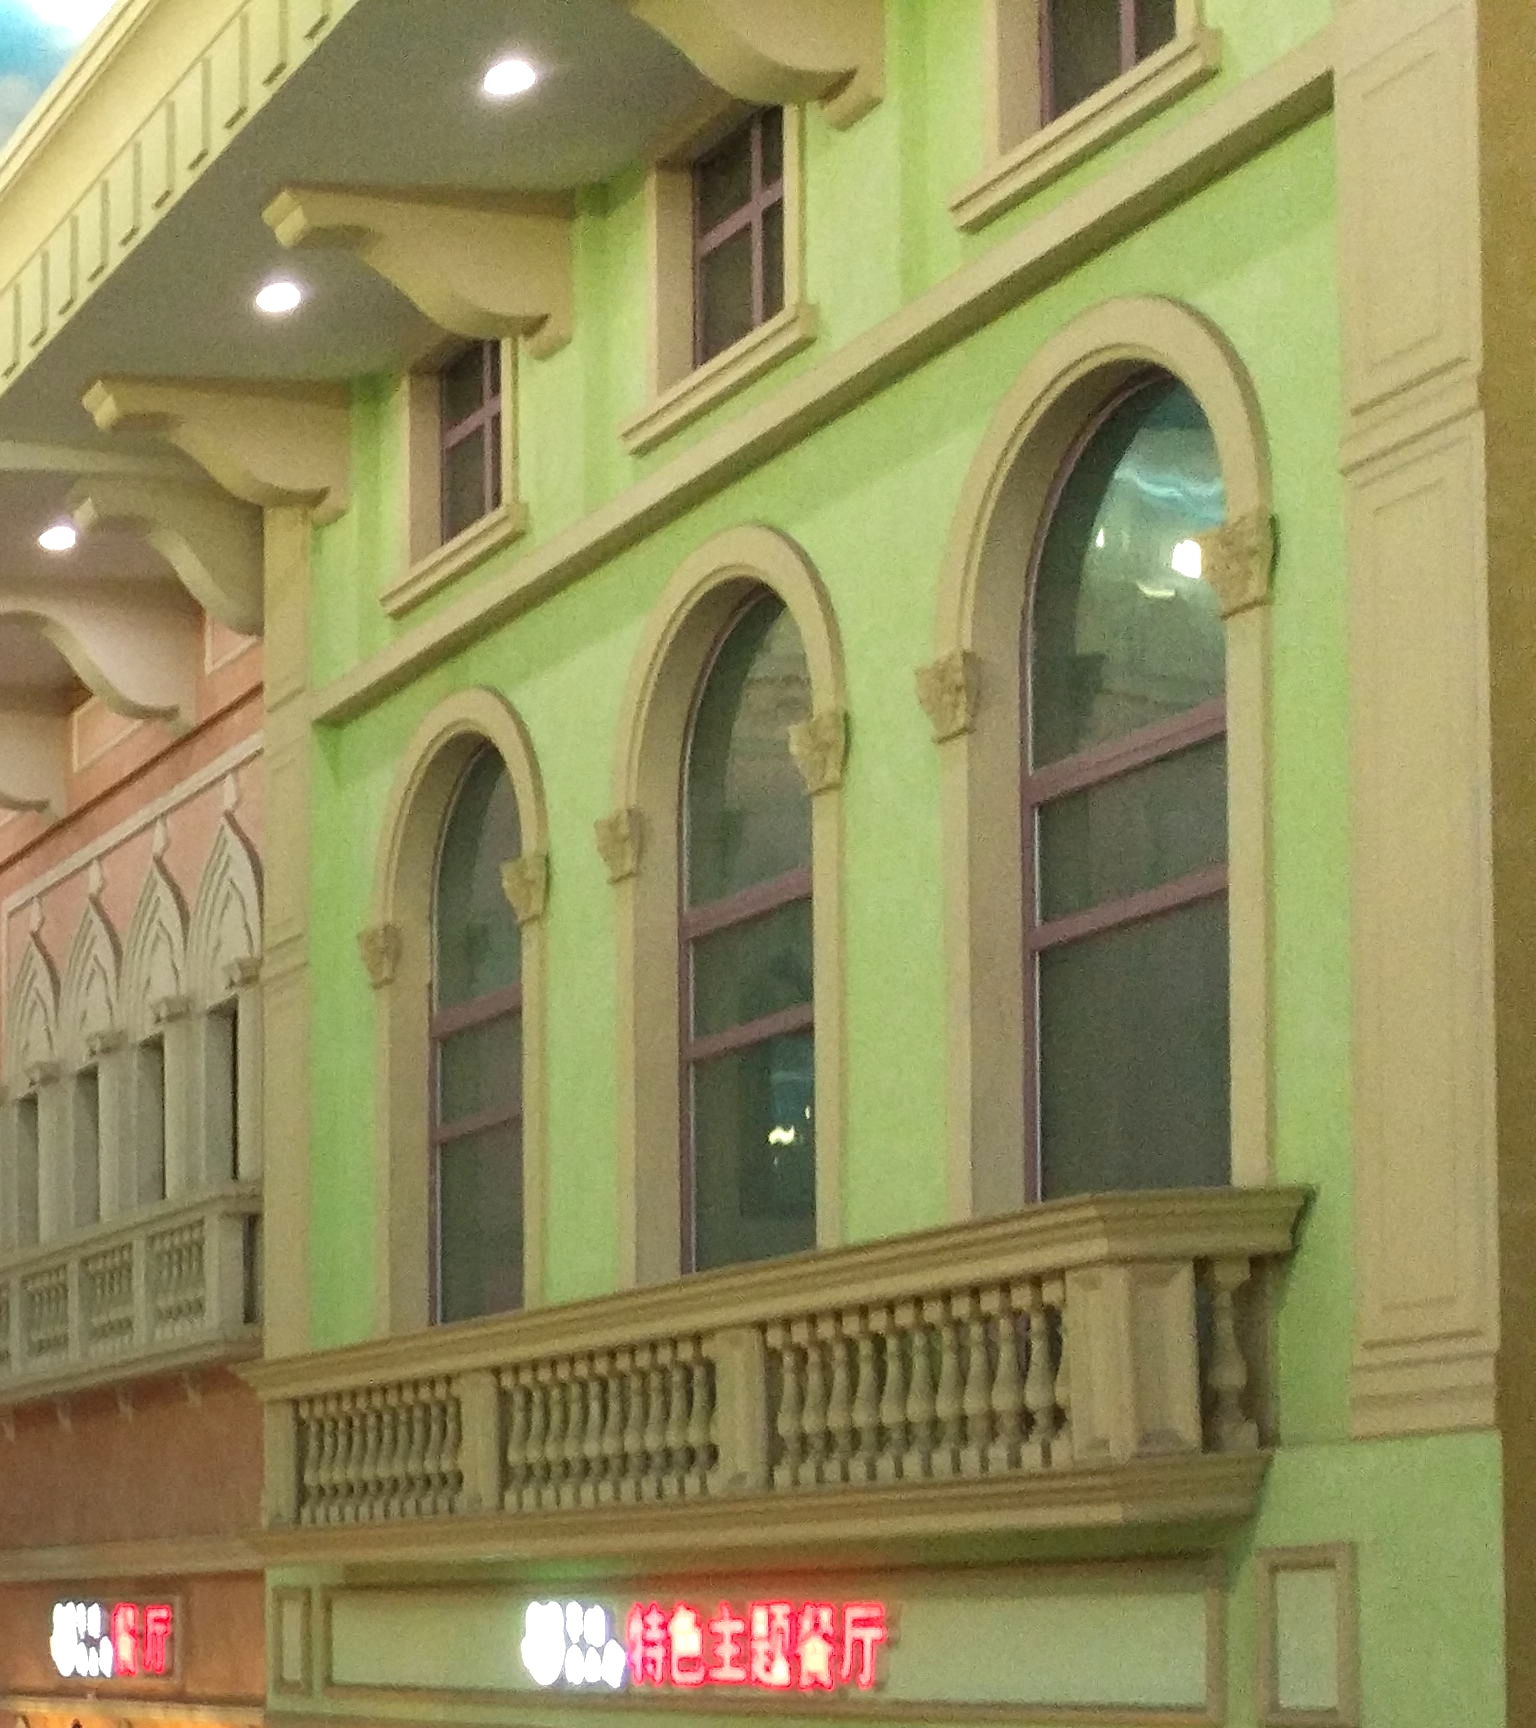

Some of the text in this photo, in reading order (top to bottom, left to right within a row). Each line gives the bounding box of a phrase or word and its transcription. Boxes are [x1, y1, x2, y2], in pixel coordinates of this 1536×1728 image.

[626, 1602, 885, 1690] 特色主题餐厅
